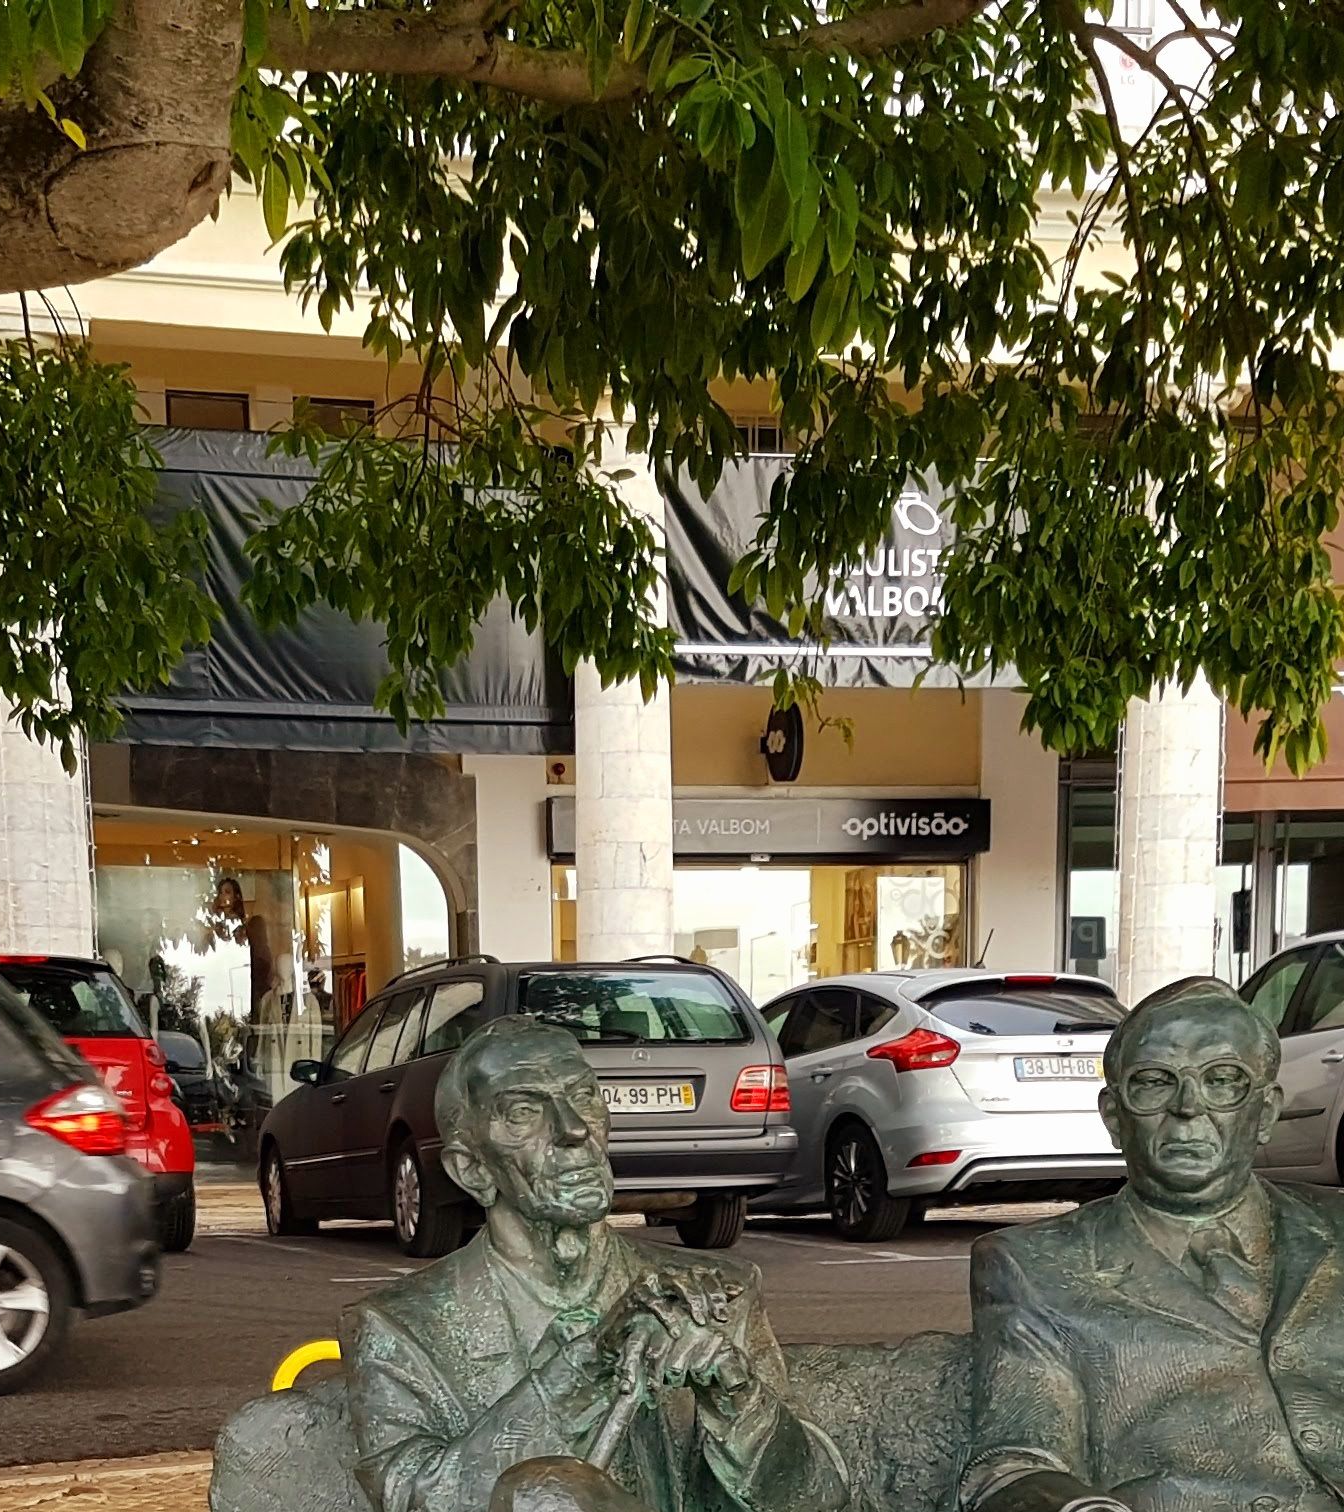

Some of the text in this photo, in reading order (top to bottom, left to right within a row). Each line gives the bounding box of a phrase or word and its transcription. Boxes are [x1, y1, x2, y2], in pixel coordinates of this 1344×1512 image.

[828, 548, 946, 578] ULIST
[697, 819, 770, 835] VALBOM
[842, 812, 969, 840] optivisão
